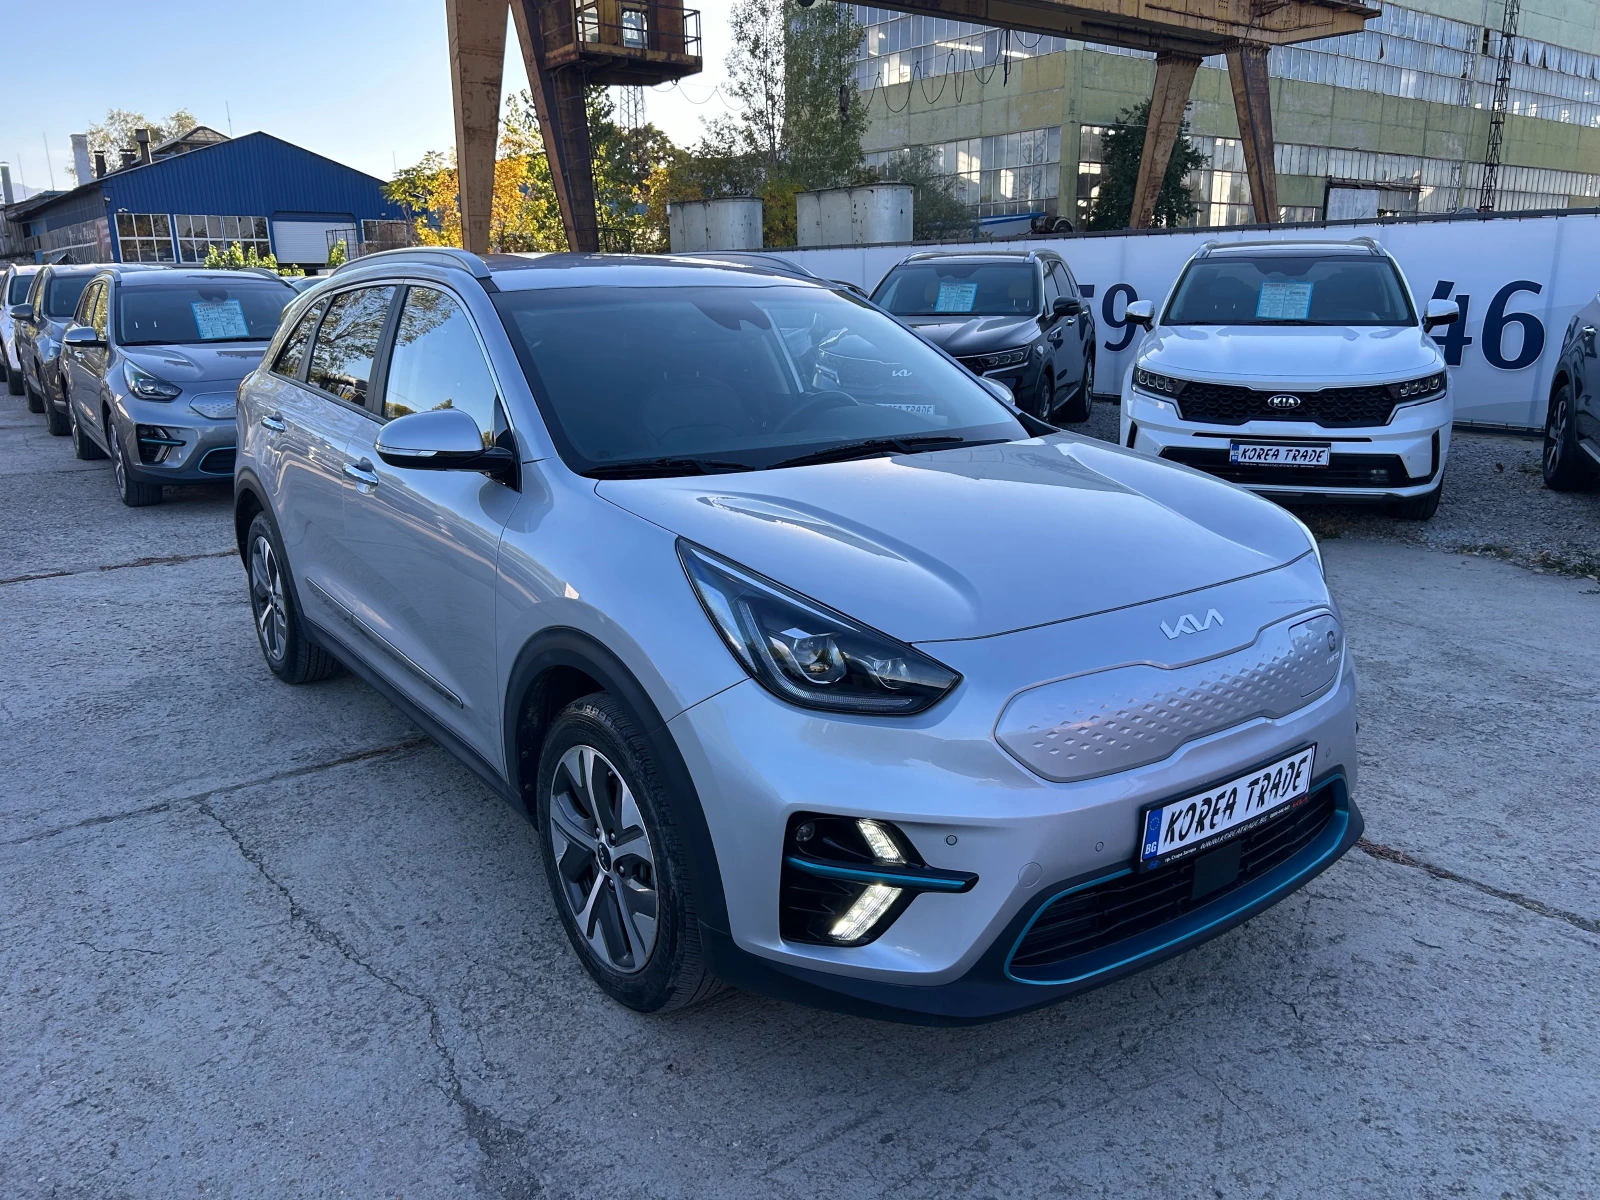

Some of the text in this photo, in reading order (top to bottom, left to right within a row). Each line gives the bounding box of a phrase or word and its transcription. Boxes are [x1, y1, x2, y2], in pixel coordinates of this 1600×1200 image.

[1078, 280, 1545, 370] 9 46
[1273, 397, 1295, 407] KIA
[1240, 447, 1326, 462] KOREA TRADE
[1160, 608, 1225, 640] KIA
[1163, 754, 1309, 846] KOREA TRADE
[1145, 841, 1157, 855] BG
